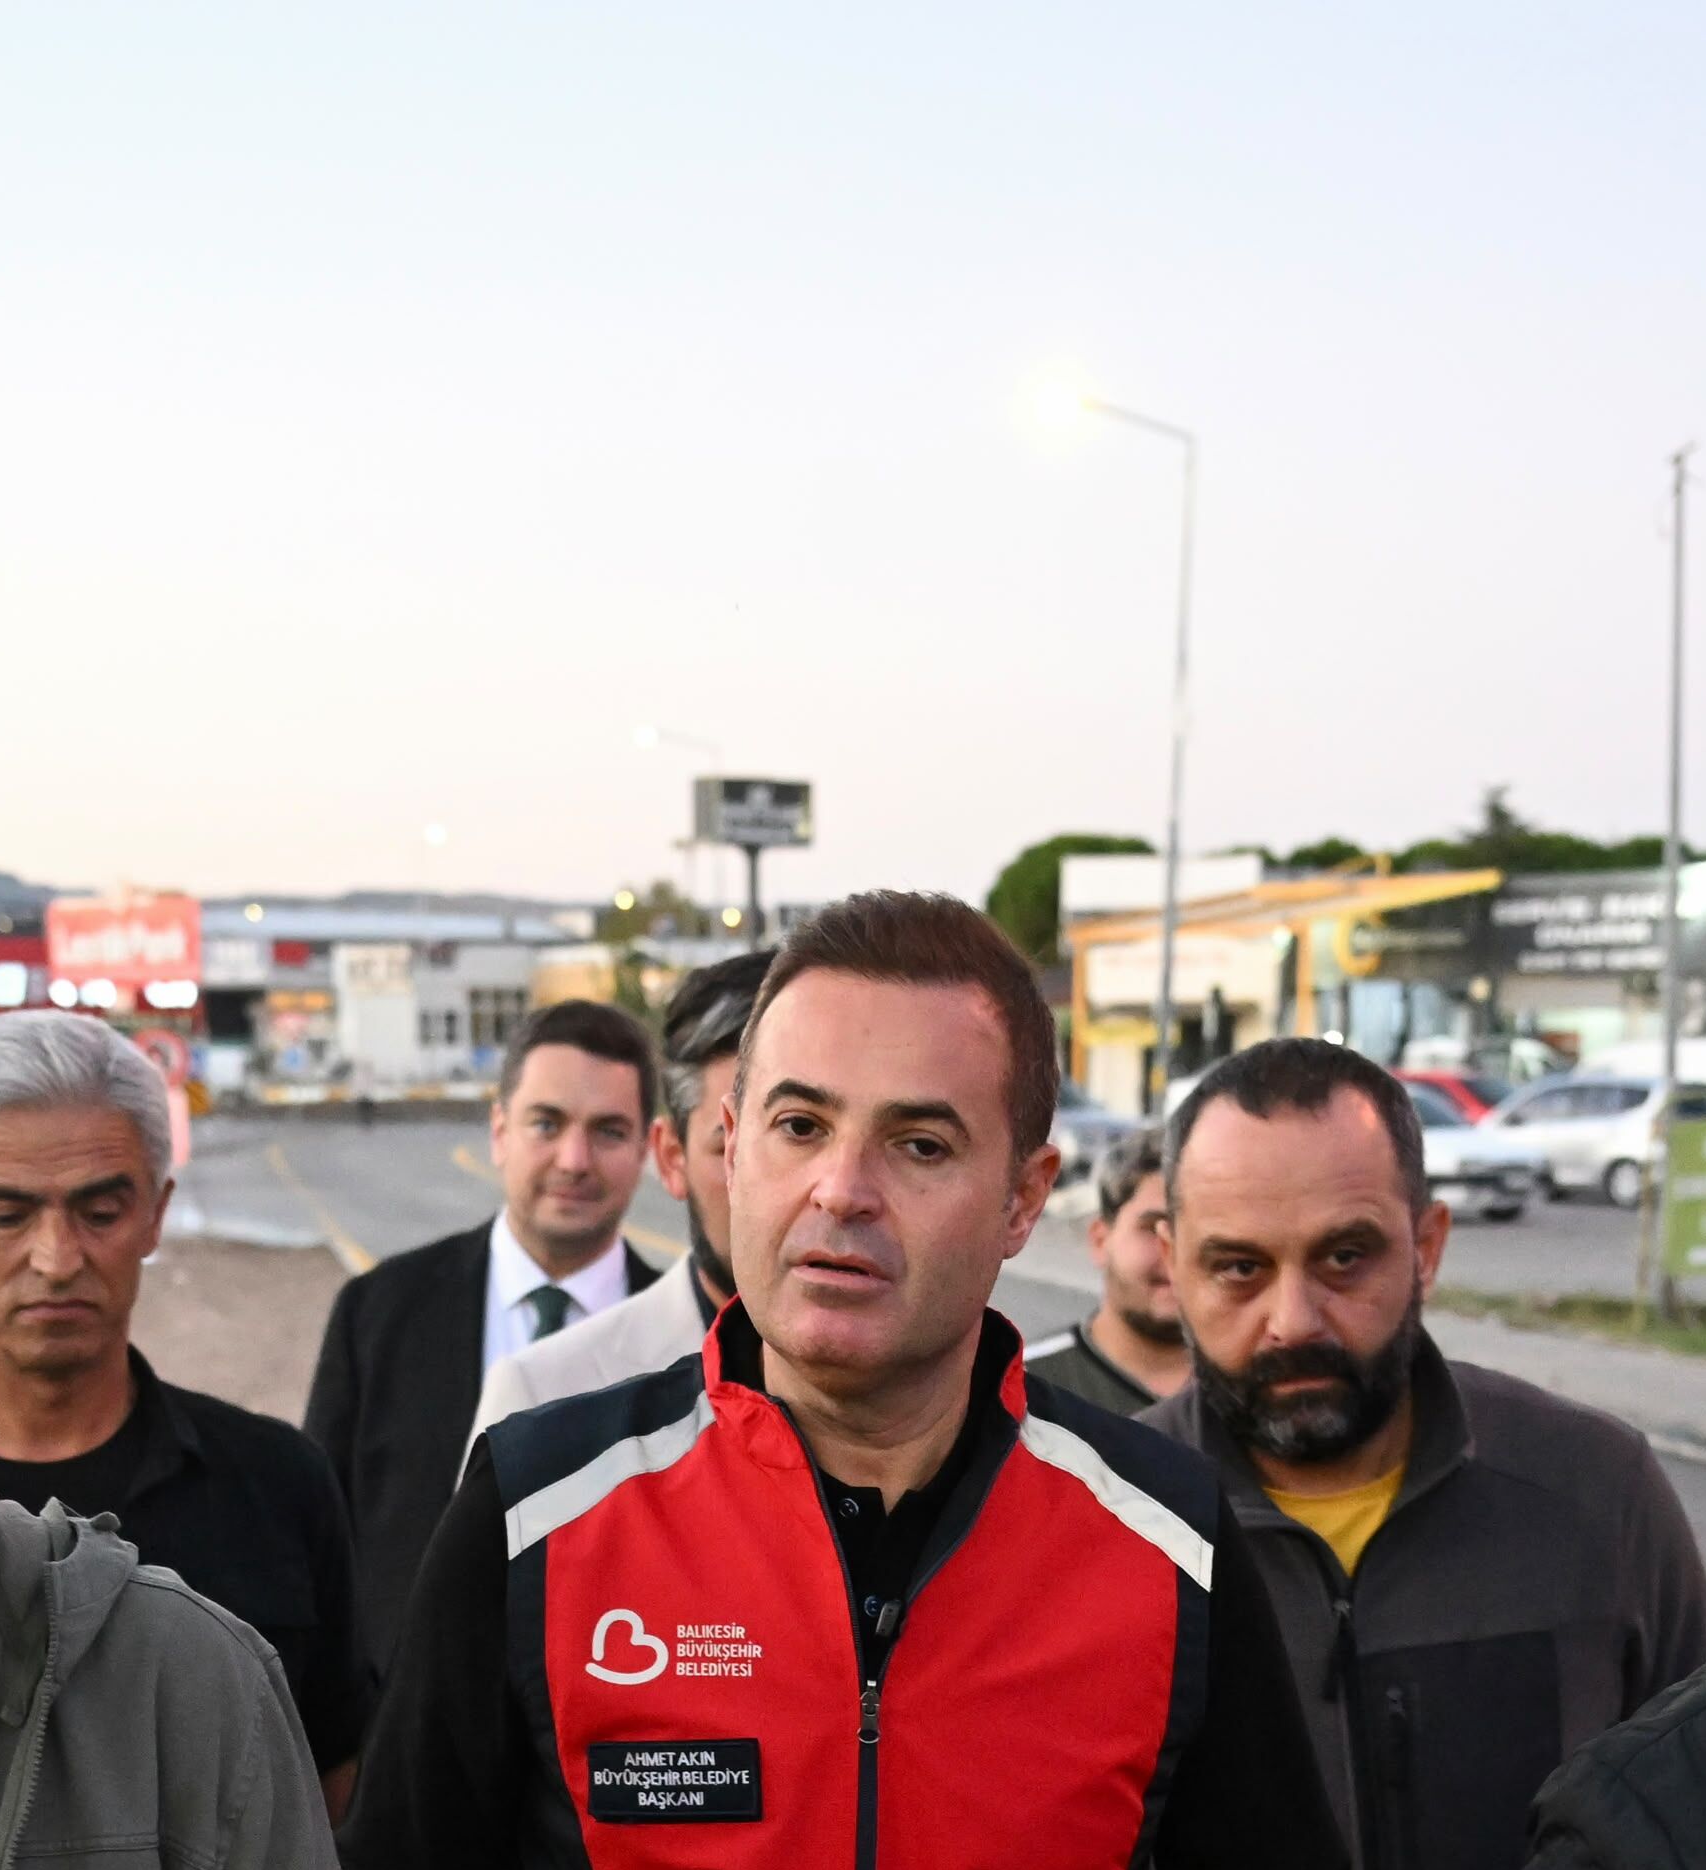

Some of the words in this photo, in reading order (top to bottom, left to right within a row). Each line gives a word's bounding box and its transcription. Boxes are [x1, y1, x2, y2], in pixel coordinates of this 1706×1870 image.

[676, 1622, 746, 1639] BALIKESİR
[676, 1640, 762, 1661] BÜYÜKŞEHİR
[675, 1659, 753, 1677] BELEDİYESİ
[624, 1751, 676, 1767] AHMET
[676, 1750, 716, 1767] AKIN
[593, 1768, 682, 1790] BÜYÜKŞEHİR
[682, 1768, 750, 1785] BELEDİYE
[637, 1791, 705, 1810] BAŞKANI
